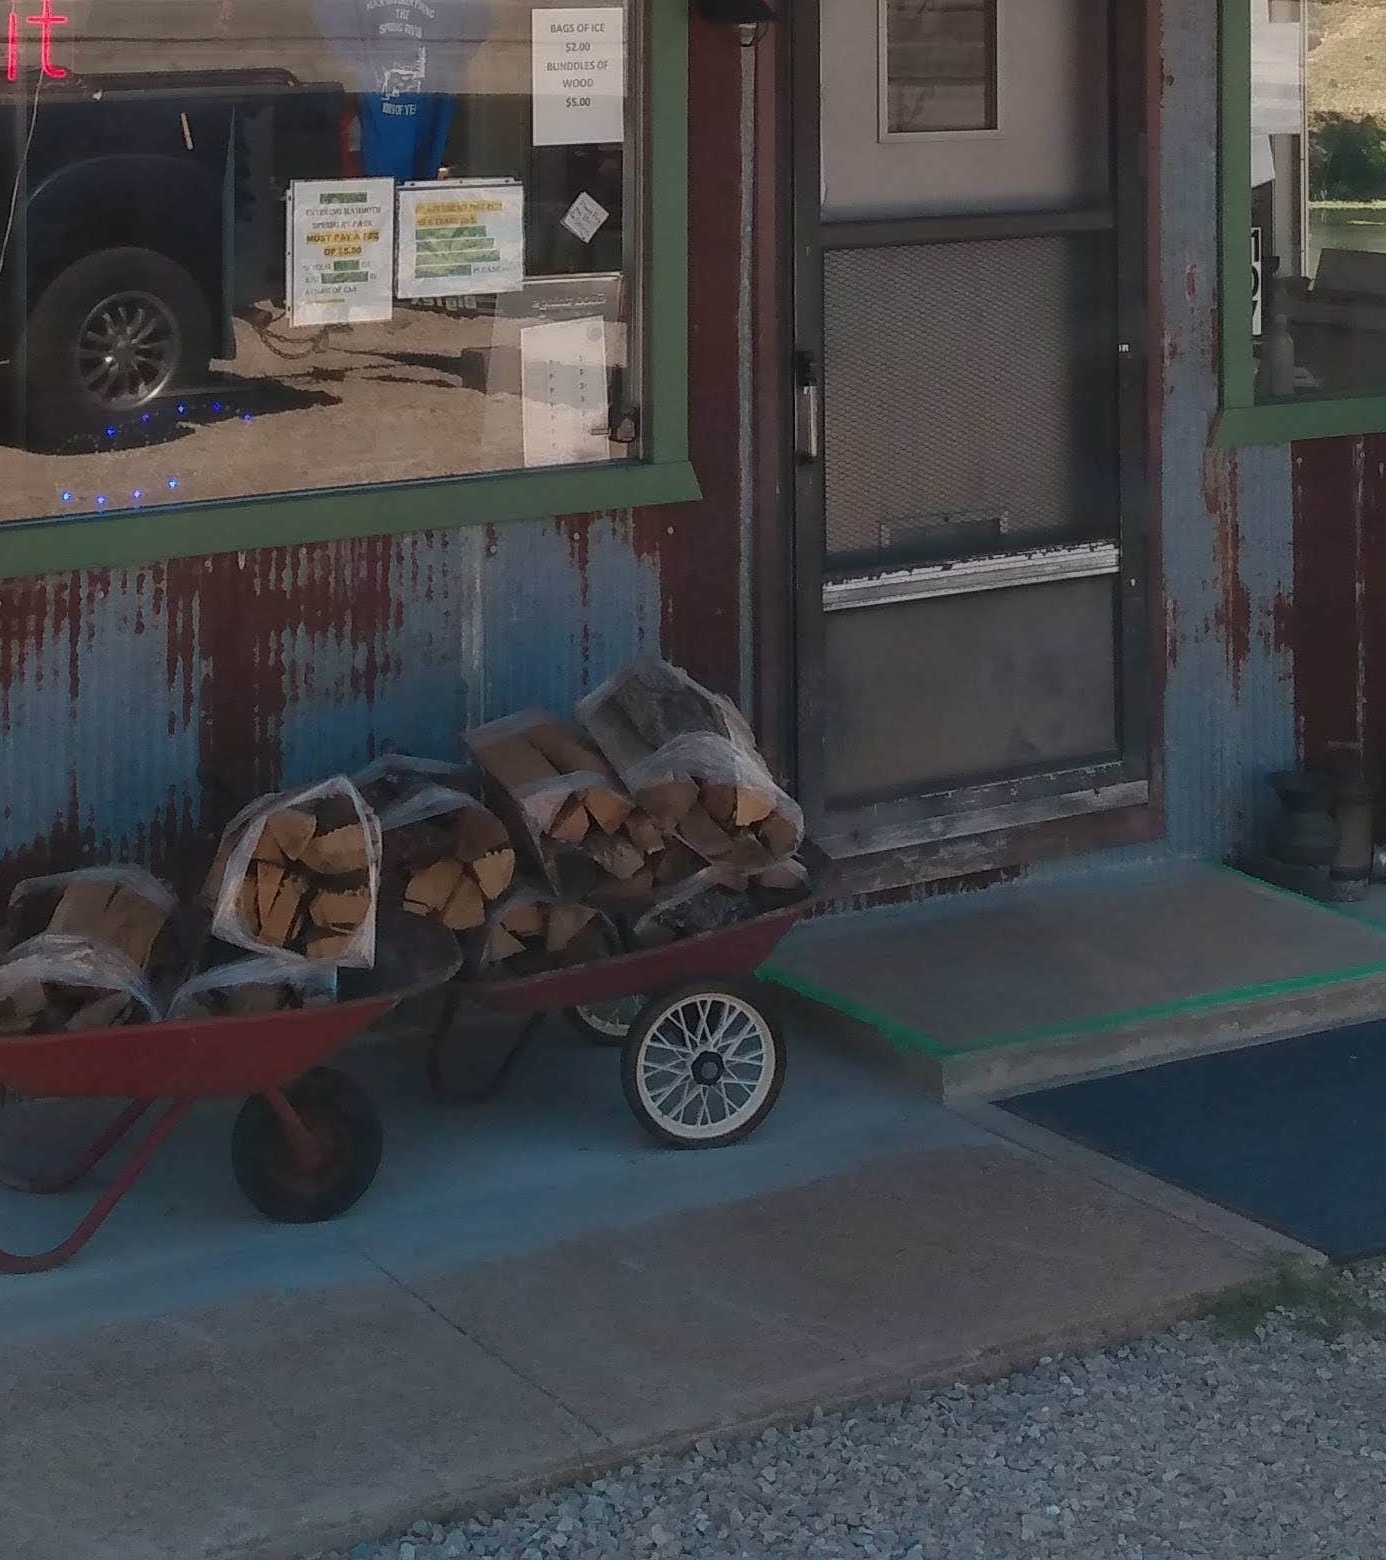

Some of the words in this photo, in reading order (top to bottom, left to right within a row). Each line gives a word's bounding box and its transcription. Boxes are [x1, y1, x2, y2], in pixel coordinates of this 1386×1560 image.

[550, 24, 575, 33] BAGS
[576, 24, 590, 32] OF
[591, 23, 605, 32] ICE
[565, 42, 591, 53] $2.00
[596, 60, 609, 70] OF
[563, 79, 594, 88] WOOD
[565, 97, 591, 108] $5.00
